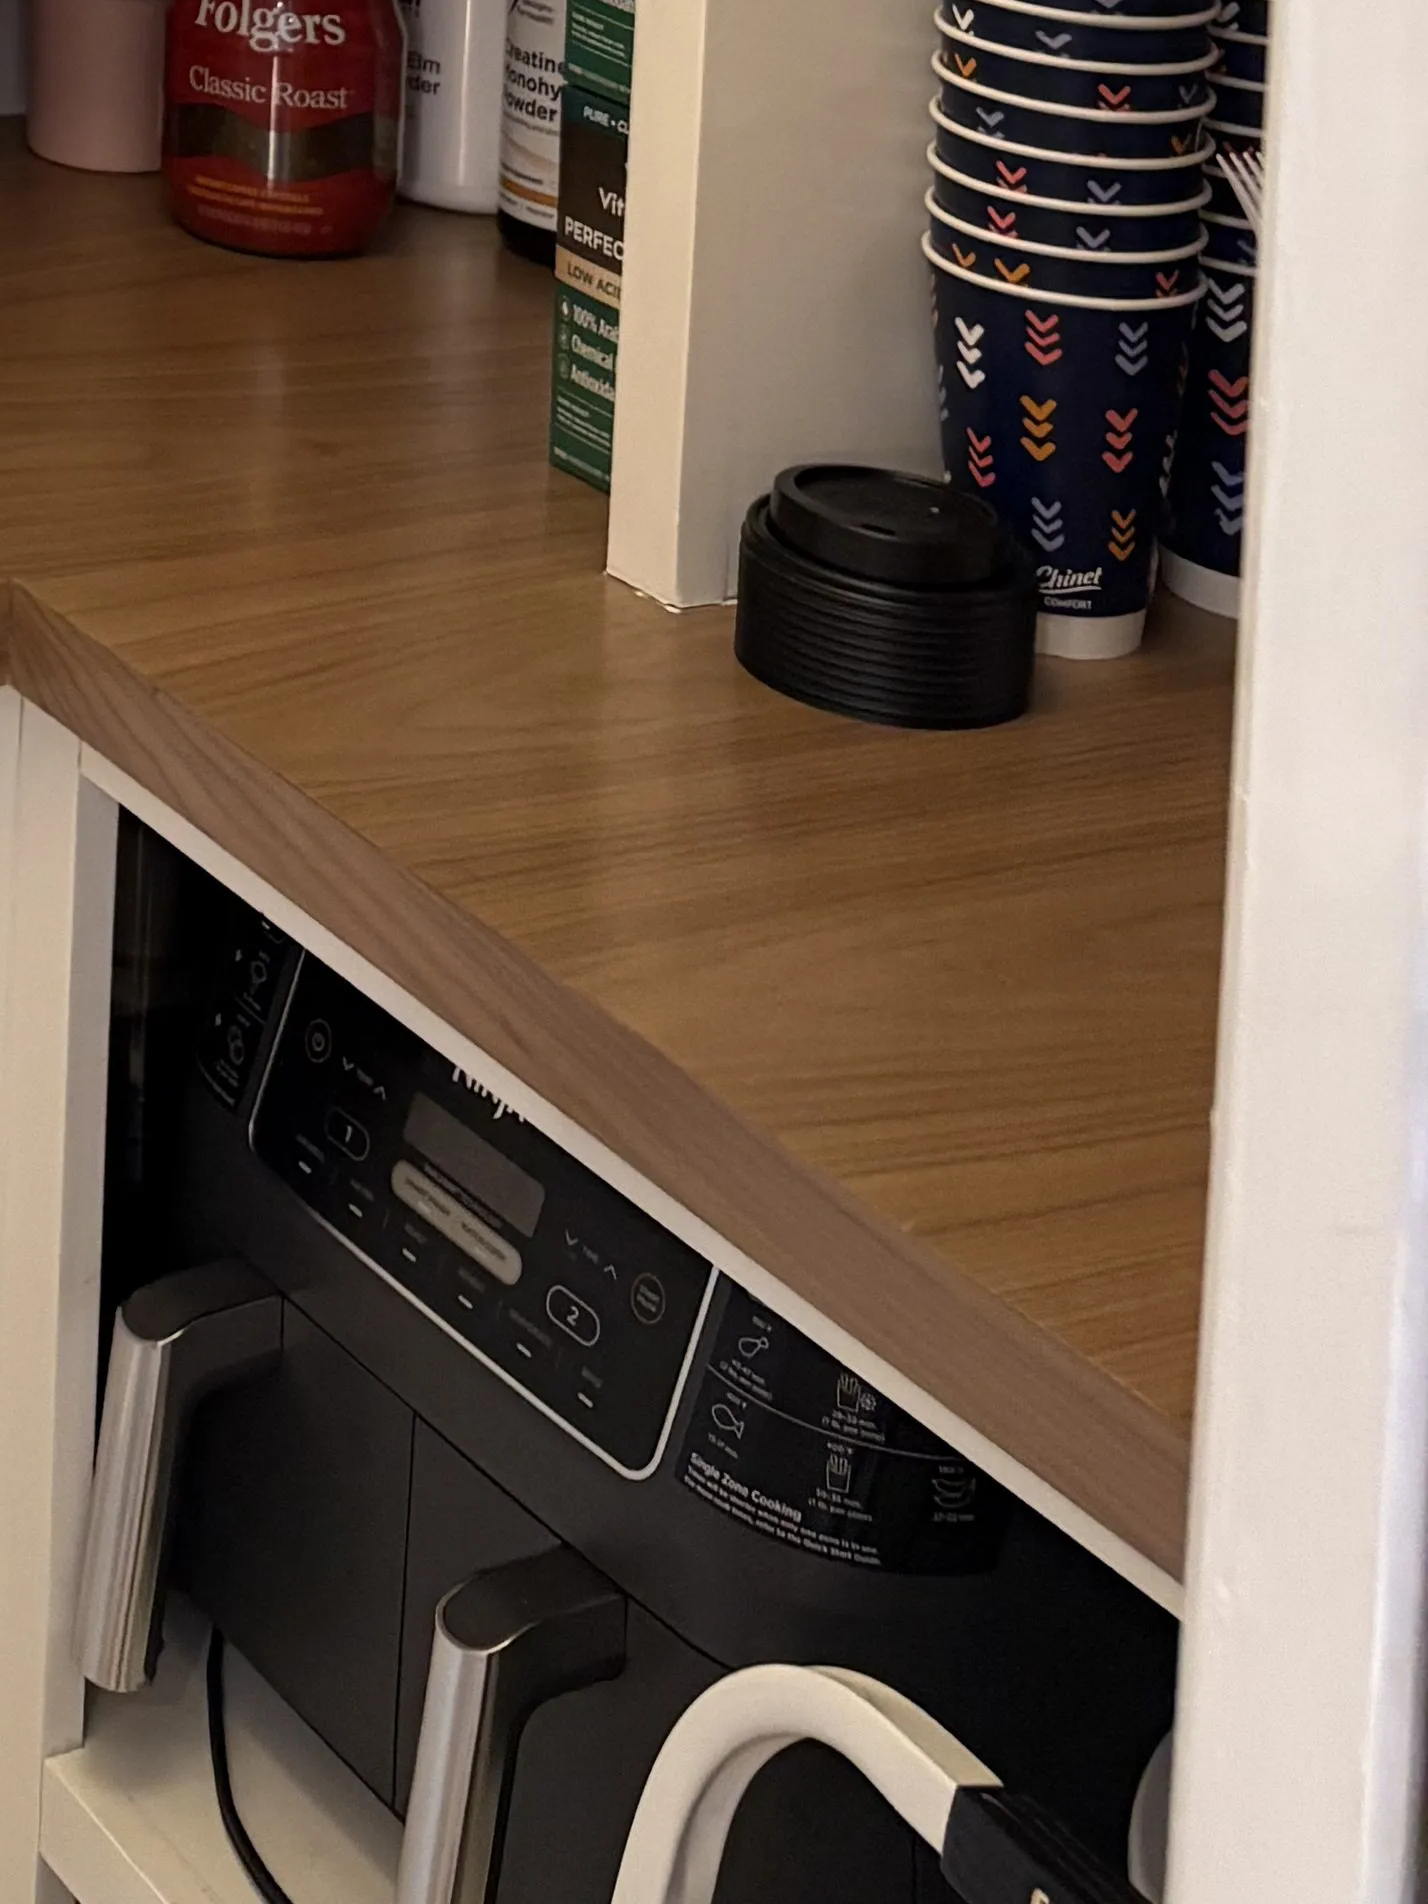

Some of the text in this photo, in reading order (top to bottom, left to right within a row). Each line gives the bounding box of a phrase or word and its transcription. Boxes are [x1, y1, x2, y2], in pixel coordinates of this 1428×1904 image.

[189, 65, 347, 109] Classic Roast
[1036, 562, 1102, 591] Chinet
[1043, 595, 1094, 612] COMFORT
[565, 1306, 581, 1327] 2
[751, 1488, 803, 1524] Cooking
